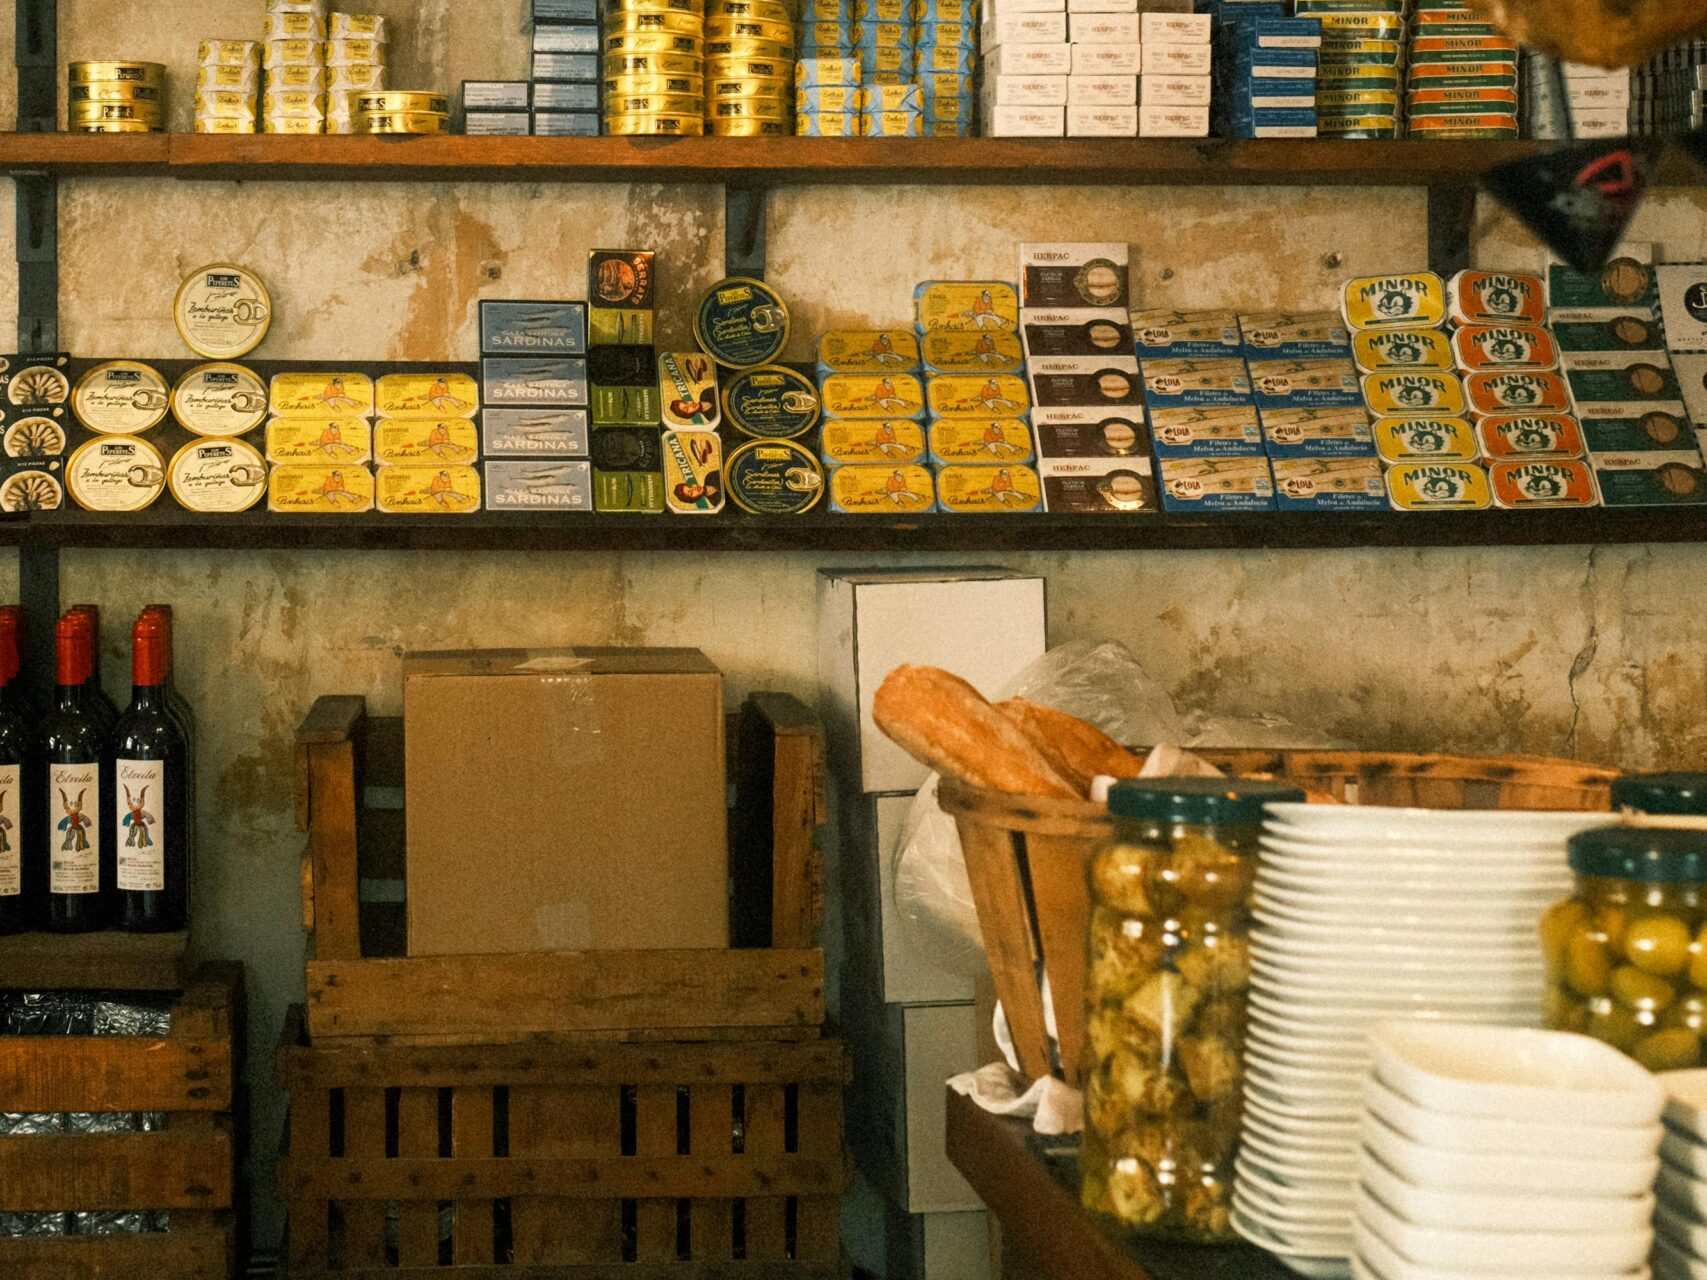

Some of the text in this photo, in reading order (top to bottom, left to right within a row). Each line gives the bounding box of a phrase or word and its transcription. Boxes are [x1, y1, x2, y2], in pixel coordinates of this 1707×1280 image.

[1331, 17, 1369, 25] MINOR
[1324, 42, 1362, 50] MINOR
[1445, 39, 1482, 48] MINOR
[1324, 67, 1361, 75] MINOR
[1446, 65, 1484, 73] MINOR
[1323, 94, 1361, 102] MINOR
[1443, 91, 1480, 99] MINOR
[1323, 119, 1361, 127] MINOR
[1443, 117, 1481, 125] MINOR
[1033, 252, 1070, 260] HERPAC
[632, 256, 649, 306] SERRATS
[1360, 278, 1428, 304] MINOR
[1472, 276, 1532, 300] MINOR
[188, 301, 235, 314] Zamburiñas
[929, 319, 965, 331] Pinhais
[1153, 329, 1170, 338] LOLA
[1261, 331, 1279, 340] LOLA
[1472, 330, 1539, 348] MINOR
[492, 335, 576, 347] SARDINAS
[1369, 333, 1437, 351] MINOR
[829, 358, 867, 367] Pinhais
[932, 358, 969, 367] Pinhais
[664, 357, 689, 399] TRICANA
[1163, 377, 1181, 387] LOLA
[1272, 377, 1289, 387] LOLA
[1482, 374, 1551, 392] MINOR
[1379, 376, 1447, 394] MINOR
[86, 391, 134, 402] Zamburiñas
[184, 393, 233, 404] Zamburiñas
[493, 387, 578, 399] SARDINAS
[278, 401, 316, 411] Pinhais
[384, 401, 421, 412] Pinhais
[831, 402, 869, 413] Pinhais
[937, 403, 975, 413] Pinhais
[1173, 426, 1190, 436] LOLA
[1284, 426, 1301, 436] LOLA
[1390, 420, 1458, 439] MINOR
[1496, 419, 1565, 439] MINOR
[492, 439, 579, 451] SARDINAS
[274, 447, 312, 458] Pinhais
[383, 448, 421, 459] Pinhais
[832, 446, 870, 457] Pinhais
[939, 447, 977, 457] Pinhais
[668, 437, 694, 483] TRICANA
[80, 467, 130, 479] Zamburiñas
[182, 472, 231, 485] Zamburiñas
[1403, 465, 1473, 487] MINOR
[1506, 464, 1576, 485] MINOR
[1183, 480, 1201, 490] LOLA
[1295, 479, 1313, 489] LOLA
[277, 495, 315, 506] Pinhais
[384, 495, 423, 506] Pinhais
[495, 494, 583, 505] SARDINAS
[842, 496, 880, 507] Pinhais
[948, 495, 986, 506] Pinhais
